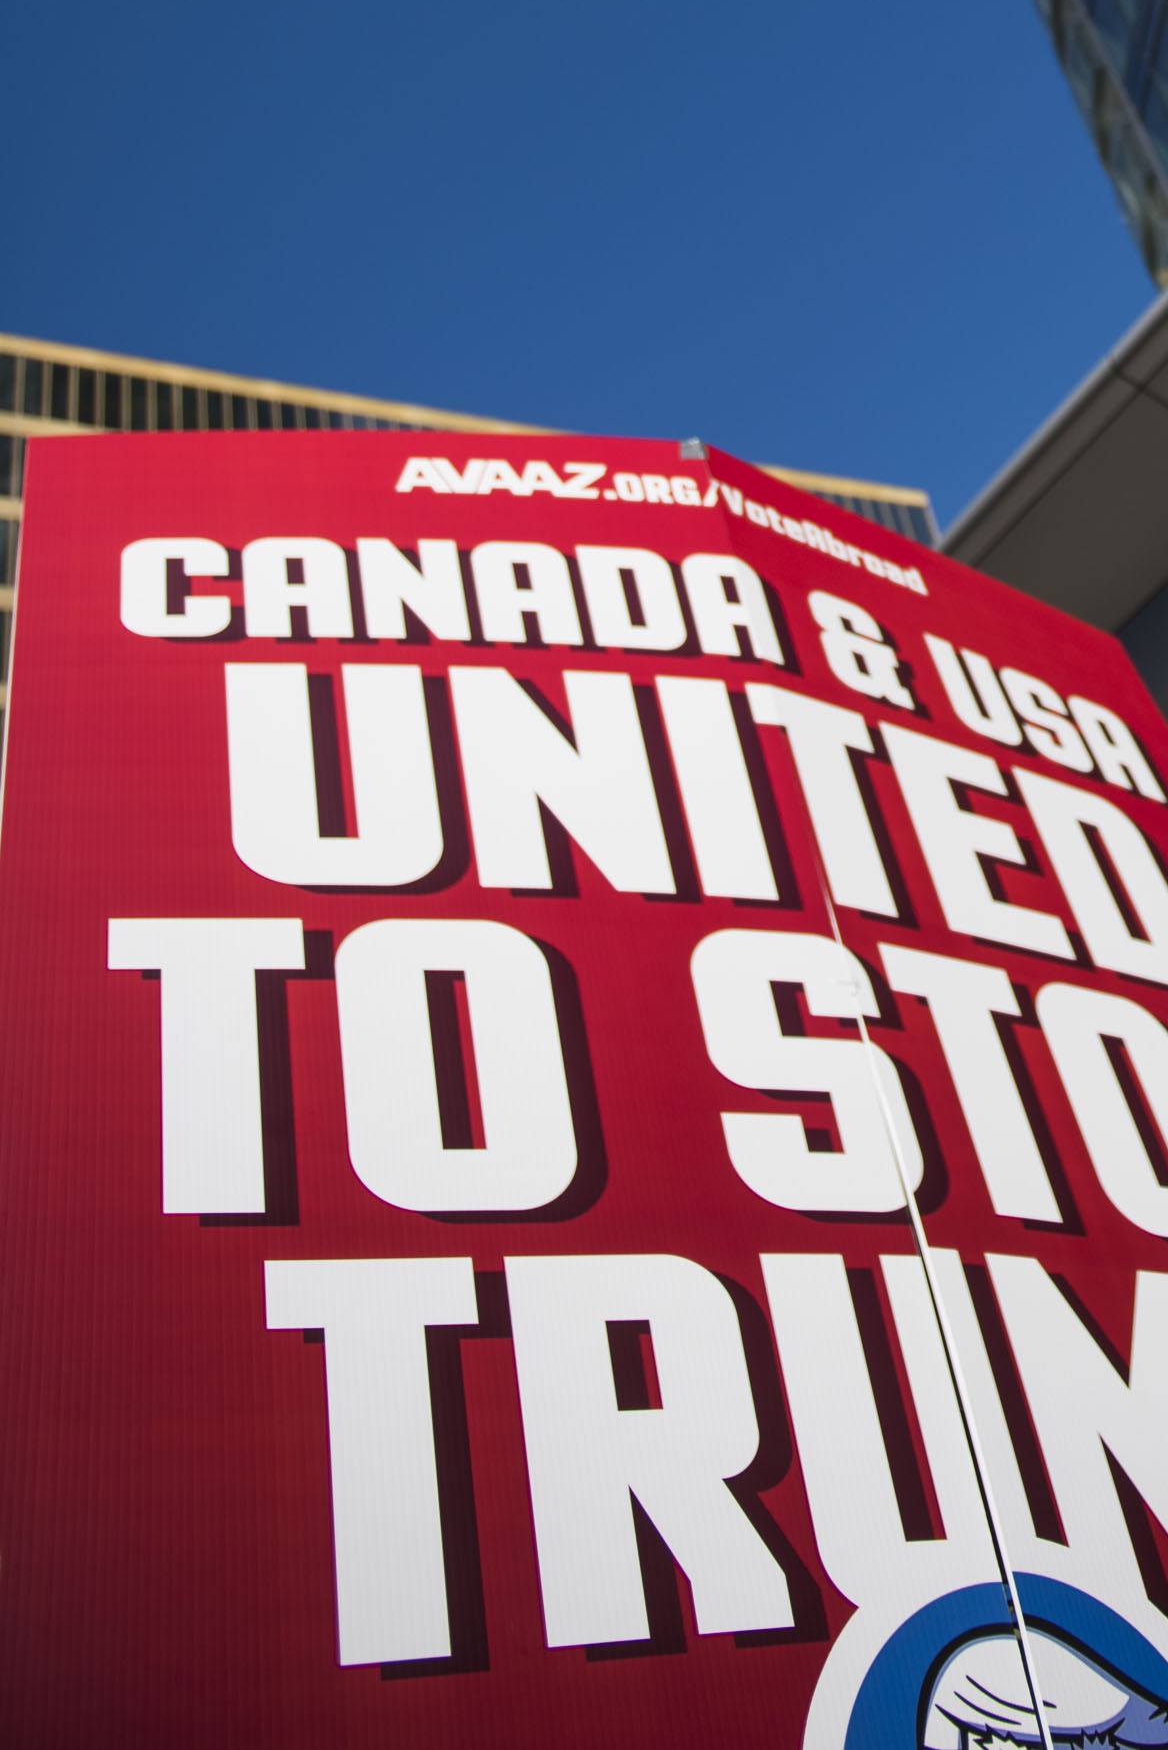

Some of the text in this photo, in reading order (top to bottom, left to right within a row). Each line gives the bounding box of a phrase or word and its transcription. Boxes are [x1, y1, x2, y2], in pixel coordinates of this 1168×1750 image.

[396, 456, 929, 596] AVAAZ.ORG/VoteAbroad
[120, 537, 1166, 804] CANADA & USA
[108, 918, 577, 1215] TO
